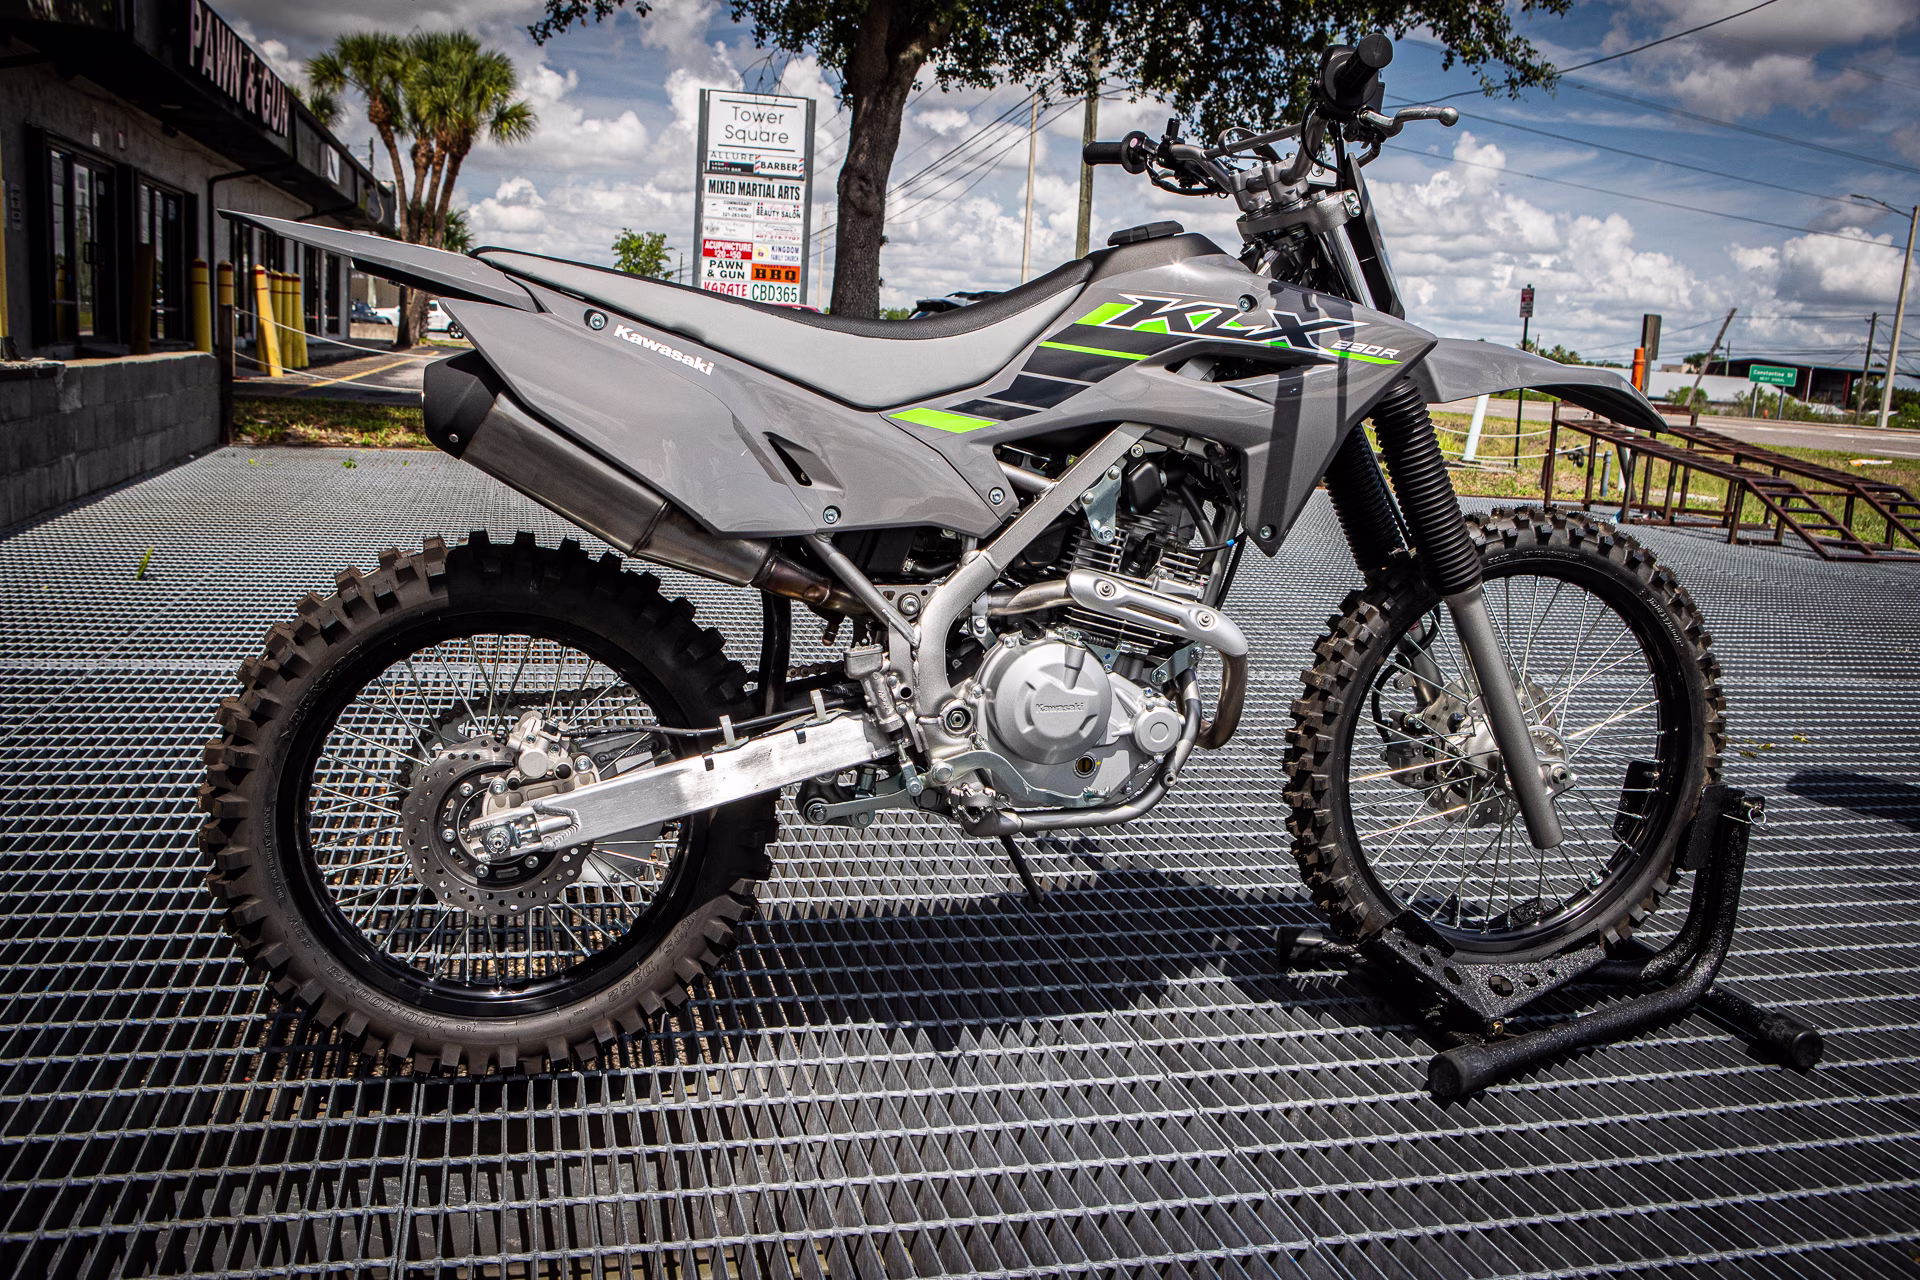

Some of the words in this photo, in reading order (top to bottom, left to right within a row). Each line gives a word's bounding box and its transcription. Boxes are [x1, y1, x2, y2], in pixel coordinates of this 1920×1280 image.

[189, 0, 243, 103] PAWN
[245, 52, 257, 114] &
[261, 67, 289, 138] GUN
[732, 105, 785, 125] Tower
[724, 124, 789, 144] Square
[710, 151, 755, 161] ALLURE
[760, 161, 798, 172] BARBER
[708, 179, 736, 195] MIXED
[738, 181, 776, 199] MARTIAL
[778, 185, 801, 201] ARTS
[756, 209, 779, 217] BEAUTY
[781, 210, 801, 219] SALON
[704, 240, 752, 252] ACUPUNCTURE
[771, 245, 800, 254] KINGDOM
[707, 269, 715, 278] &
[720, 269, 745, 280] GUN
[709, 259, 744, 270] PAWN
[704, 281, 748, 297] KARATE
[752, 283, 798, 303] CBD365
[1097, 293, 1371, 357] KLX
[613, 324, 715, 376] Kawasaki
[1331, 339, 1401, 360] 230R
[1035, 702, 1084, 714] Kawasaki
[262, 806, 273, 836] SERVICE
[604, 960, 659, 1002] D952
